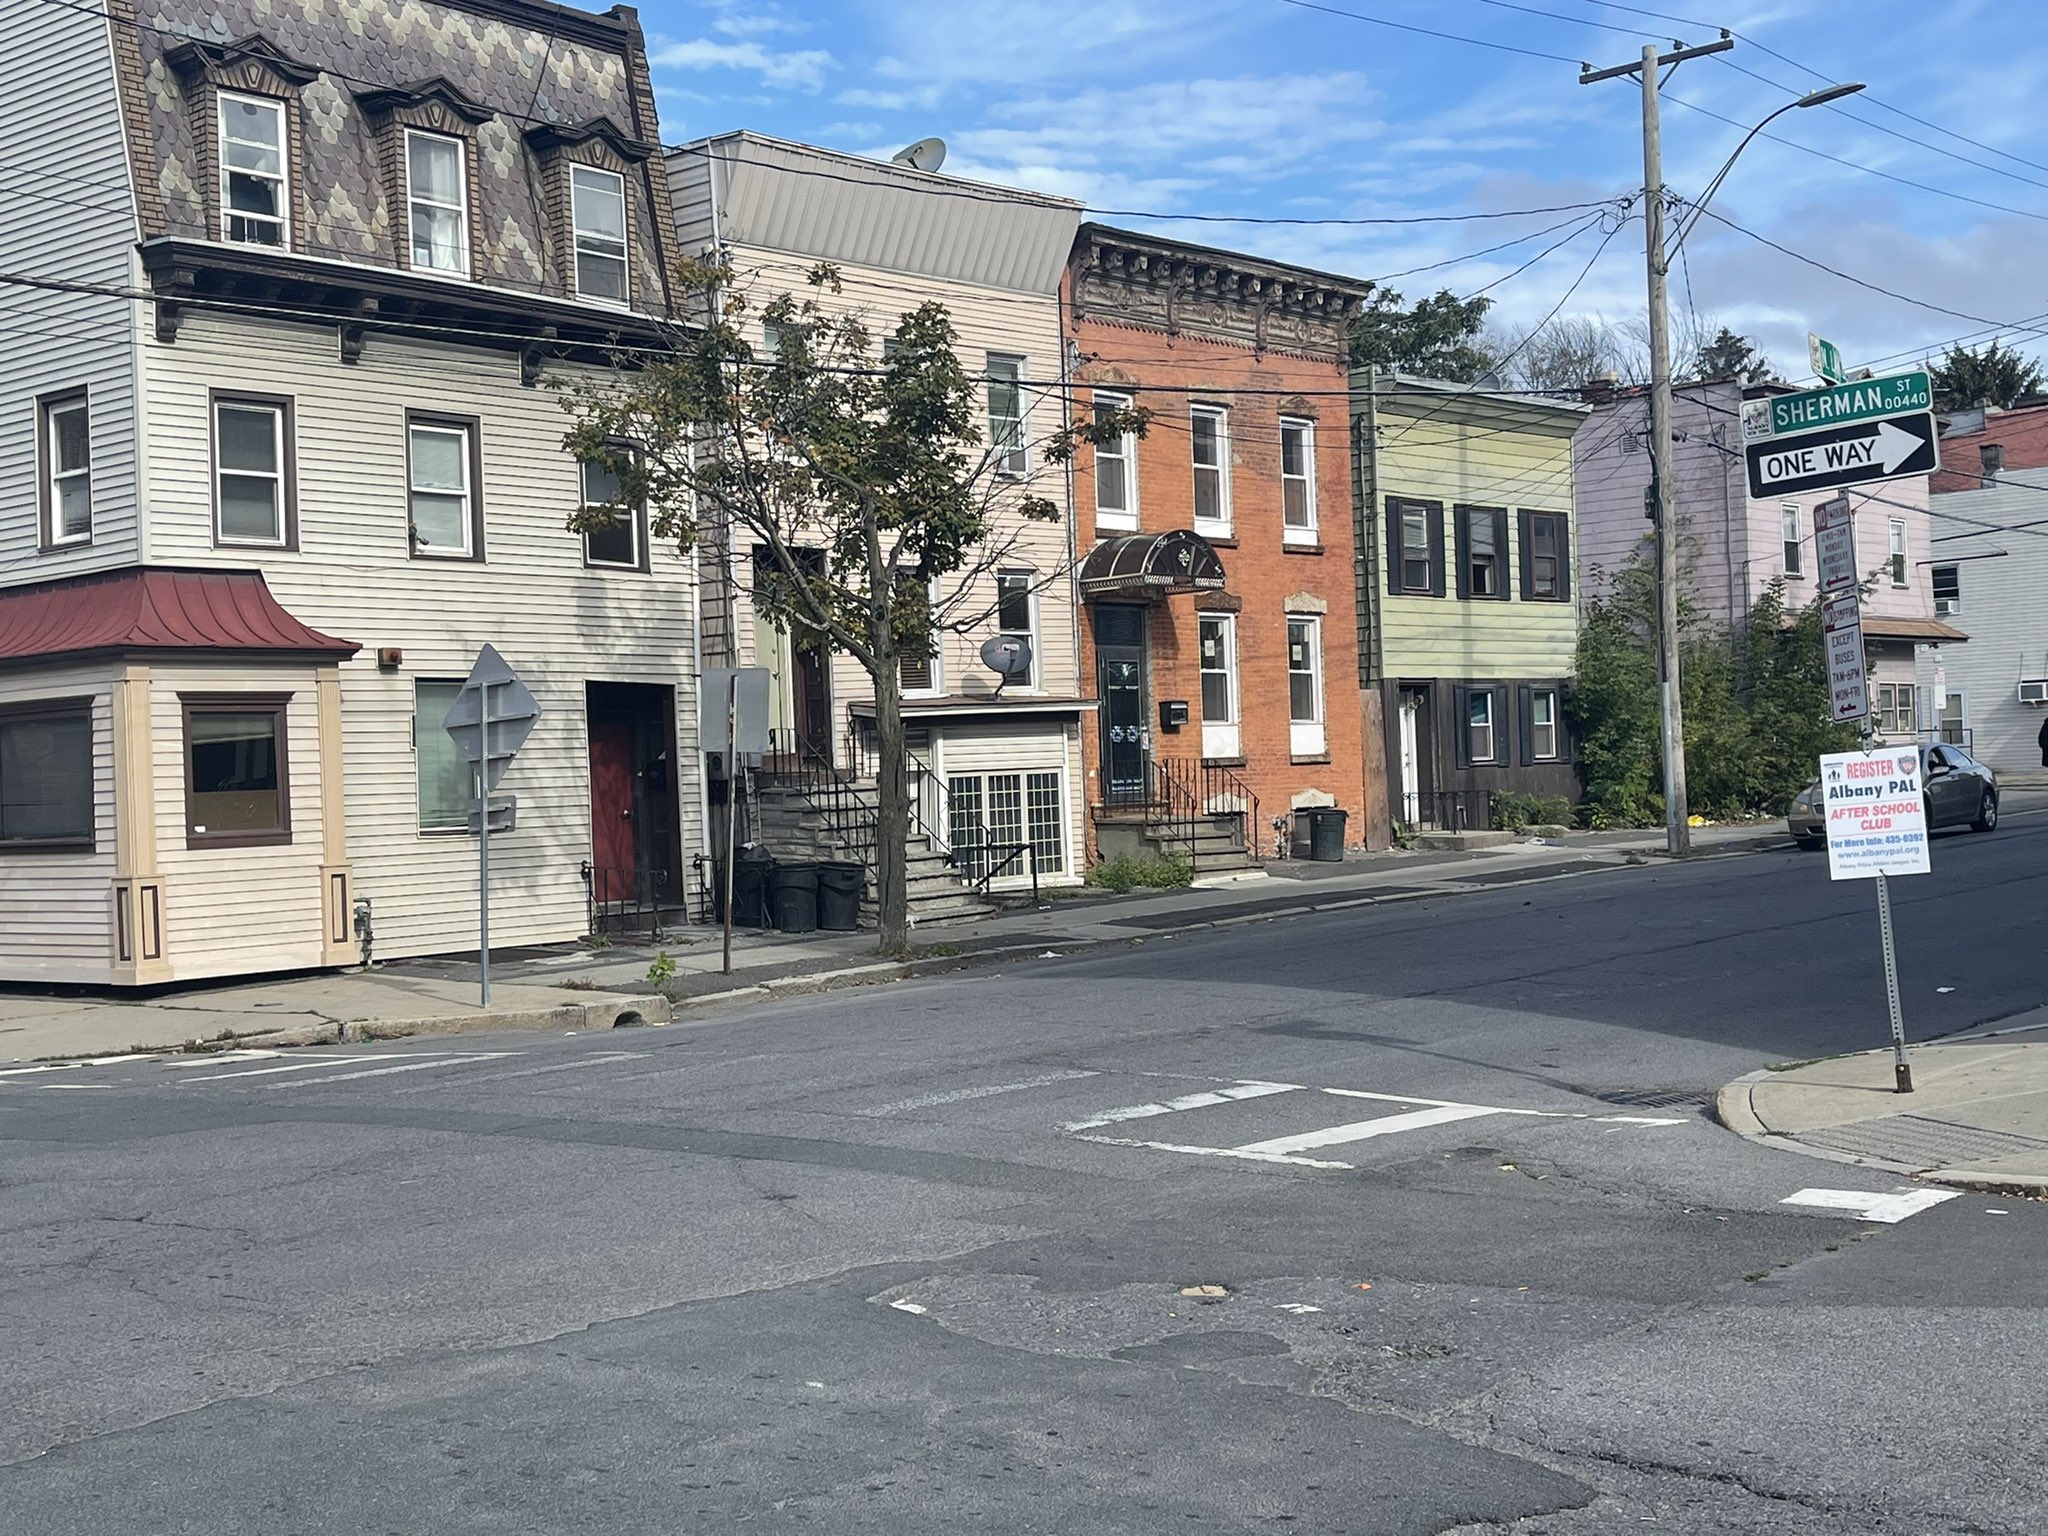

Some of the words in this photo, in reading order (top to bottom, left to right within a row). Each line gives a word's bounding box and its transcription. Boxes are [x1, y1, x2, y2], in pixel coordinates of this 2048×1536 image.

[1897, 378, 1911, 392] ST
[1776, 386, 1883, 426] SHERMAN
[1884, 391, 1927, 410] 00440
[1767, 450, 1816, 478] ONE
[1825, 439, 1876, 468] WAY
[1815, 510, 1826, 529] NO
[1824, 607, 1833, 625] NO
[1833, 606, 1858, 622] STOPPING
[1831, 631, 1855, 648] EXCEPT
[1834, 650, 1856, 666] BUSES
[1832, 667, 1860, 684] 7AM-6PM
[1835, 686, 1861, 702] MON-FRI
[1846, 759, 1894, 779] REGISTER
[1829, 784, 1883, 799] Albany
[1889, 779, 1917, 794] PAL
[1831, 806, 1870, 820] AFTER
[1872, 802, 1920, 816] SCHOOL
[1861, 818, 1892, 830] CLUB
[1831, 840, 1843, 848] For
[1844, 838, 1865, 848] More
[1866, 837, 1884, 846] Info:
[1838, 846, 1920, 859] www.albanypal.org
